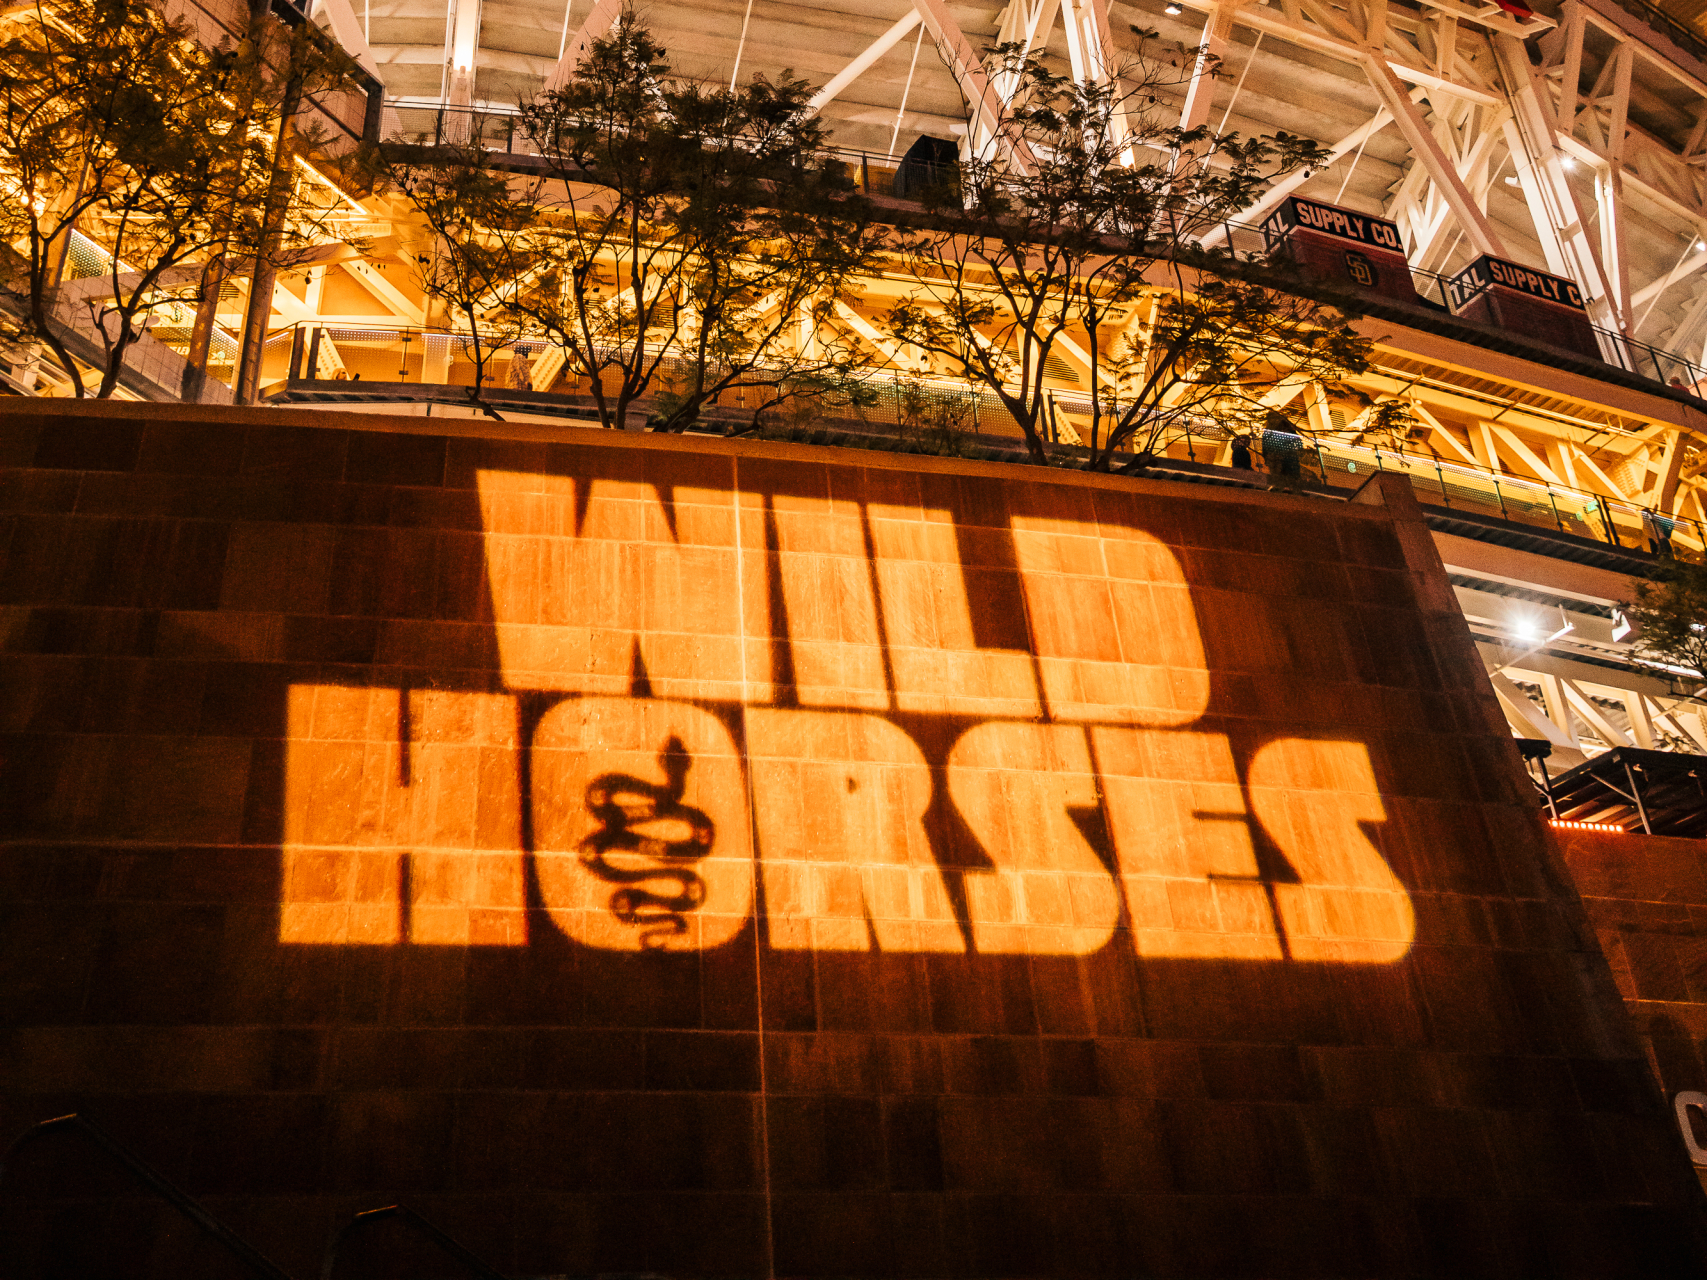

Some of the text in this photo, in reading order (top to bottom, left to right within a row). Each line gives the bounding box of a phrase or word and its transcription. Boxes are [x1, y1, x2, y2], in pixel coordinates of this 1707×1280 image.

[1296, 202, 1366, 239] SUPPLY
[1370, 222, 1403, 250] CO.
[1489, 260, 1560, 300] SUPPLY
[475, 469, 1210, 726] WILD
[279, 683, 1416, 964] HORSES
